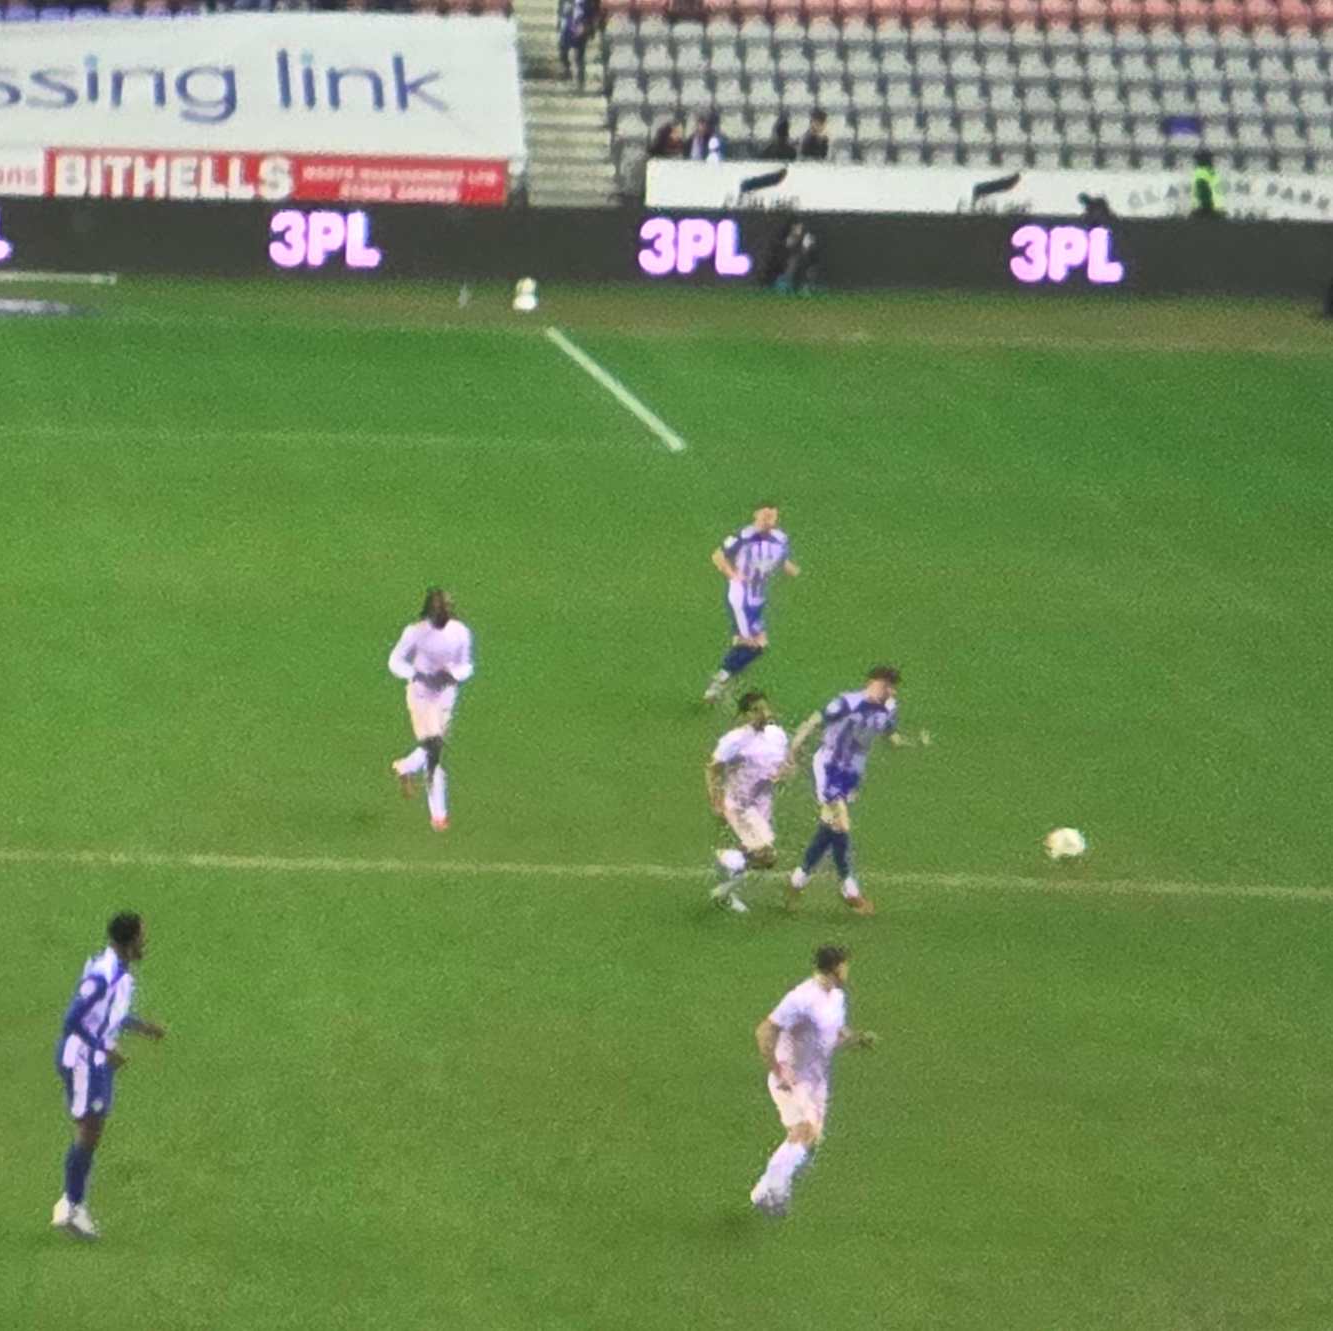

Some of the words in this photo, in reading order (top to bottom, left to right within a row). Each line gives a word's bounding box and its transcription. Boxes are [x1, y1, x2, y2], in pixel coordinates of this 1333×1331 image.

[276, 49, 451, 113] link
[54, 154, 295, 200] BITHELLS
[269, 210, 380, 267] 3PL
[638, 218, 751, 275] 3PL
[1010, 225, 1124, 282] 3PL
